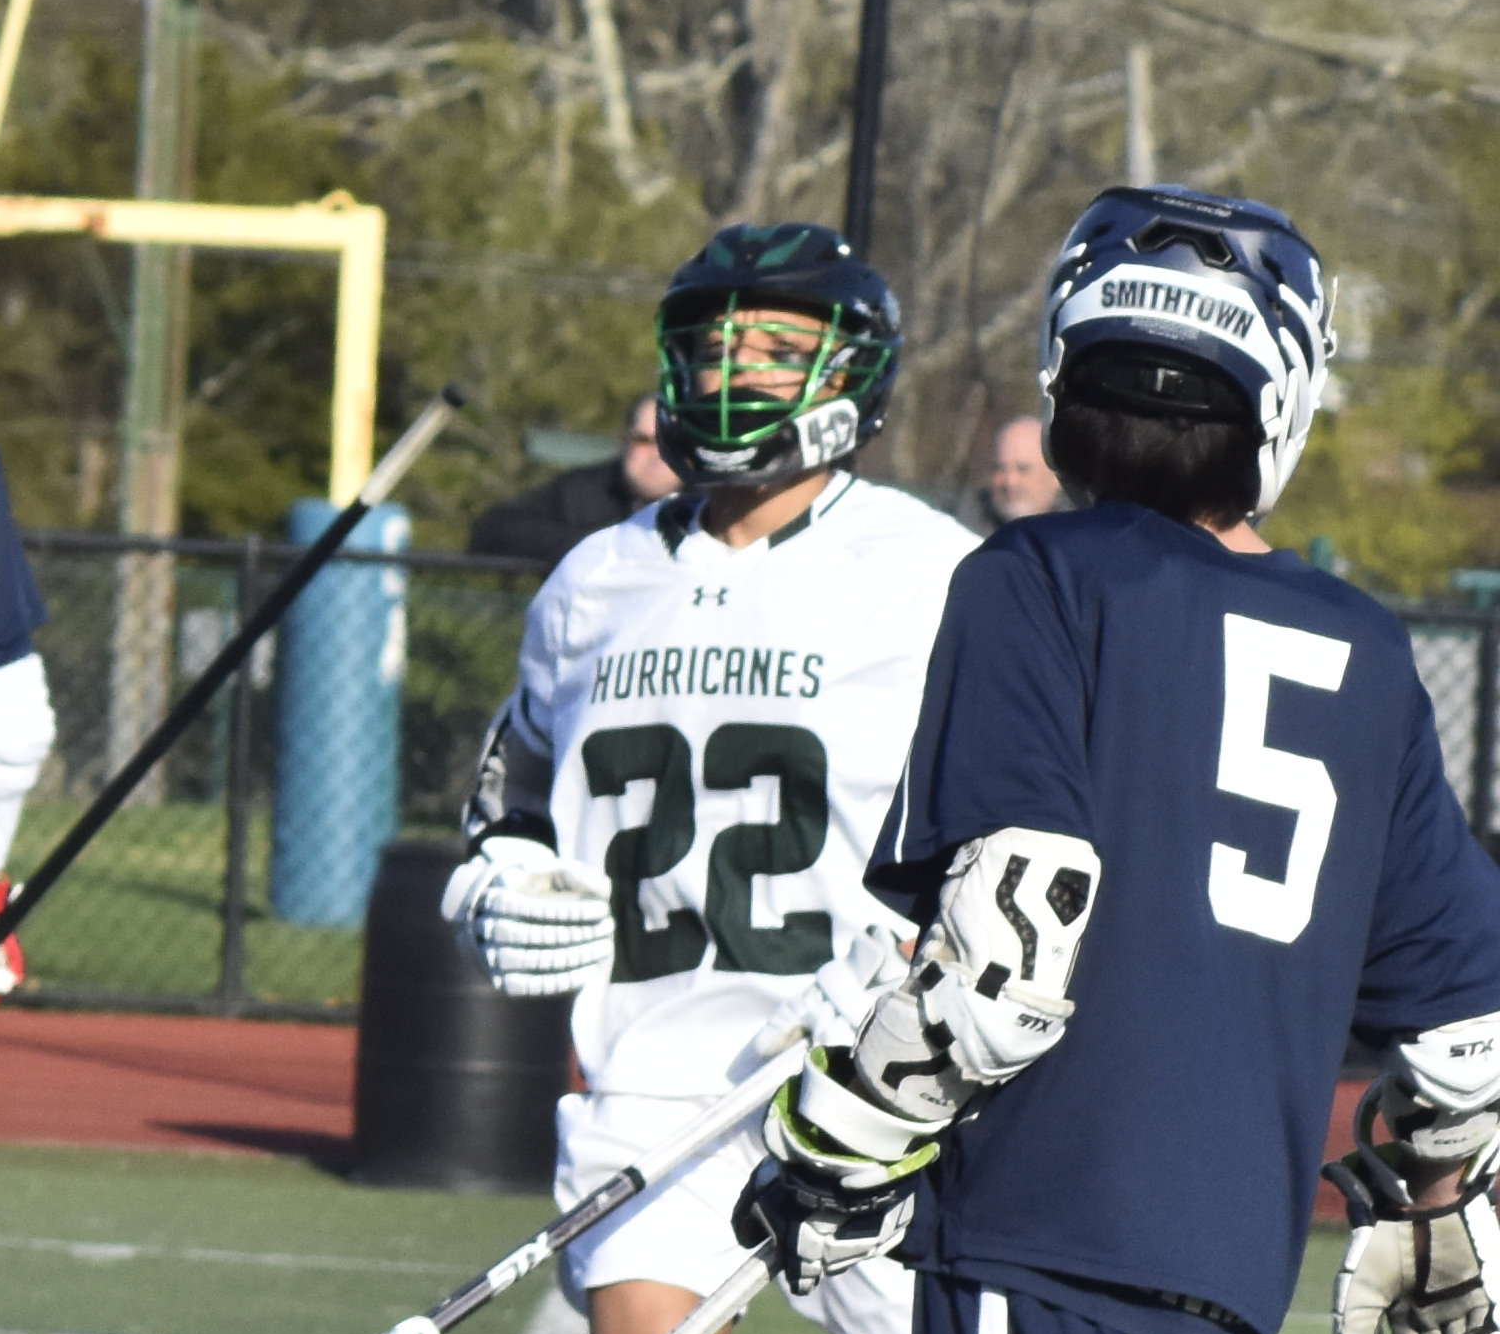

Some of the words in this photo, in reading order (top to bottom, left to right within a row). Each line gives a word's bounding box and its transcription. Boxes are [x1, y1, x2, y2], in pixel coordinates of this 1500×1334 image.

[1100, 280, 1256, 341] SMITHTOWN
[590, 646, 824, 704] HURRICANES
[1207, 612, 1353, 945] 5
[581, 722, 835, 983] 22
[1448, 1037, 1495, 1060] STX
[486, 1230, 553, 1298] STX
